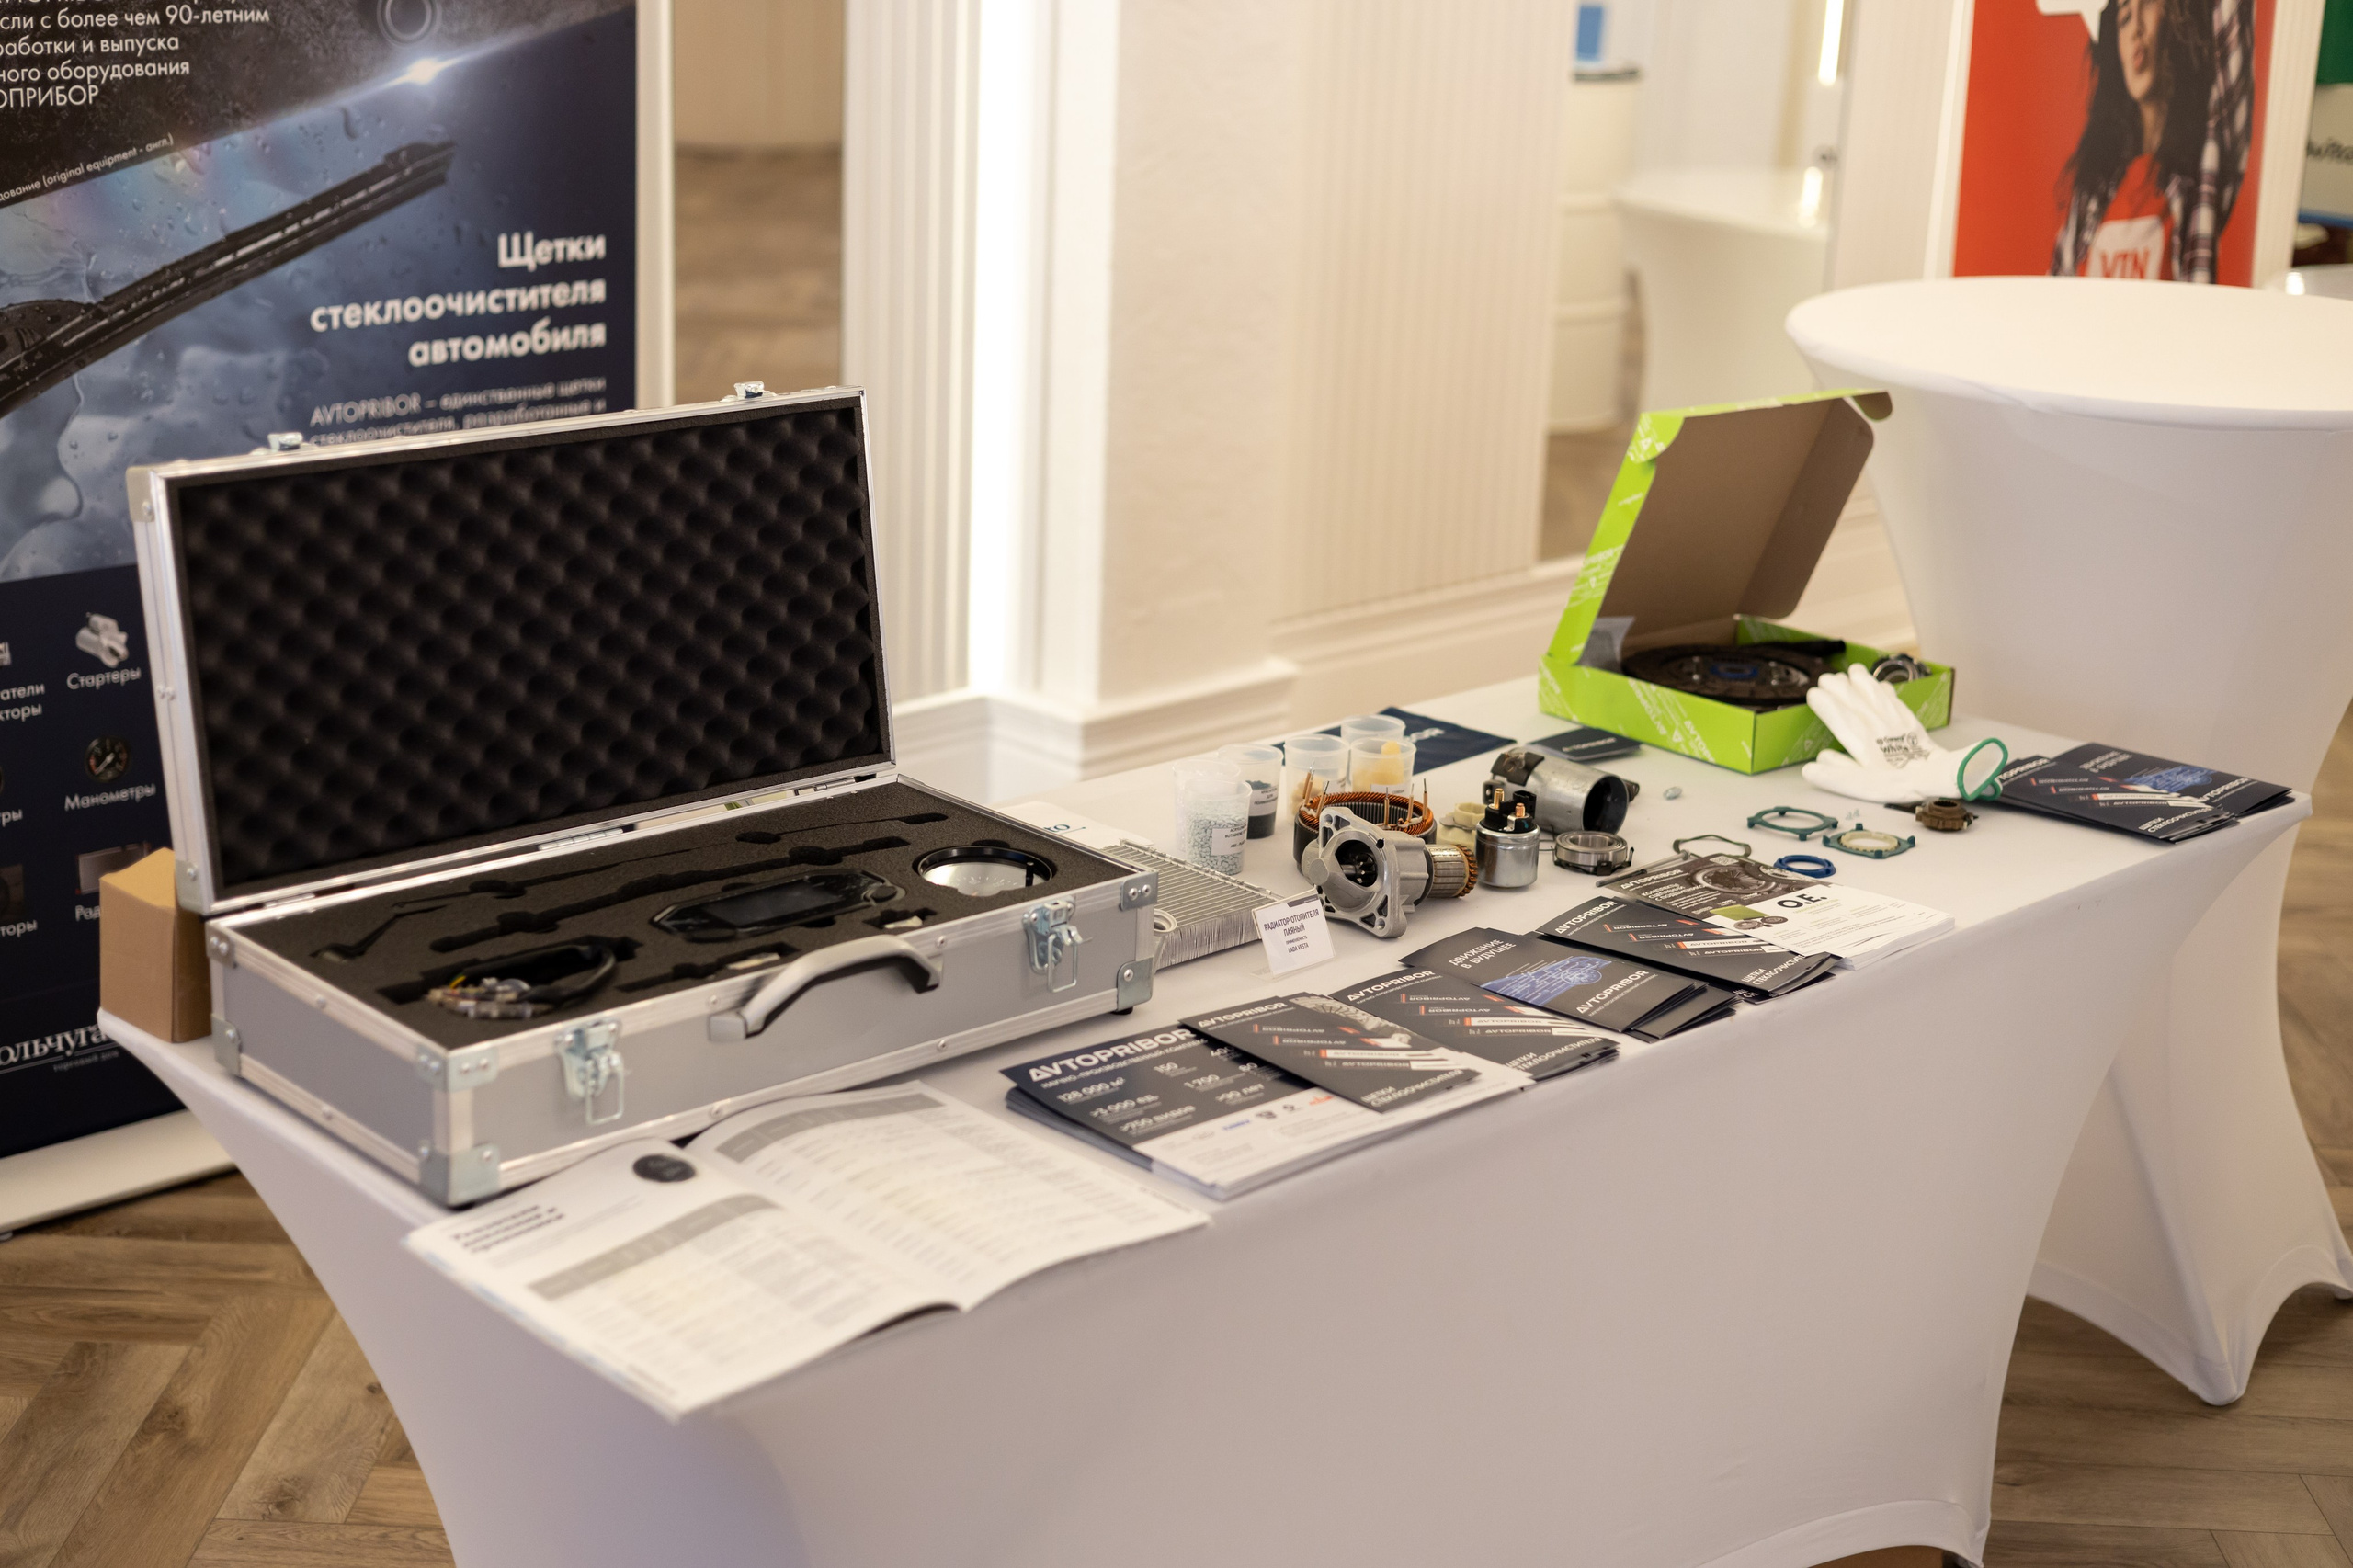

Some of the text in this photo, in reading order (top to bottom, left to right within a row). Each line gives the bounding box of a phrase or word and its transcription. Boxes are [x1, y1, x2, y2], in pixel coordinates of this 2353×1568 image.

[40, 15, 51, 28] с
[57, 7, 118, 28] более
[124, 11, 161, 26] чем
[165, 5, 270, 25] 90-летним
[0, 35, 179, 57] аботки и выпуска
[47, 59, 190, 84] оборудования
[42, 162, 85, 187] (original
[86, 147, 137, 171] equipment
[497, 230, 607, 272] Щетки
[310, 278, 607, 333] стеклоочистителя
[407, 314, 607, 368] автомобиля
[309, 391, 421, 428] AVTOPRIBOR
[66, 666, 142, 690] Стартеры
[64, 783, 156, 812] Манометры
[0, 809, 23, 827] ры
[1777, 893, 1828, 909] O.E.
[1264, 908, 1320, 931] РАДИАТОР ОТОПИТЕЛЯ
[1283, 923, 1305, 937] ПАЯНЫЙ
[1554, 900, 1619, 935] AVTOPRIBOR
[1288, 942, 1309, 954] LADA VESTA
[1448, 938, 1504, 966] ДВИЖЕНИЕ
[1469, 942, 1517, 964] БУДУЩЕЕ
[1347, 970, 1436, 1002] AVTOPRIBOR
[1575, 970, 1650, 1014] AVTOPRIBOR
[1198, 1001, 1289, 1028] AVTOPRIBOR
[1028, 1028, 1197, 1083] AVTOPRIBOR
[1517, 1036, 1603, 1071] ТЕКЛООЧИСТИТЕЛЯ
